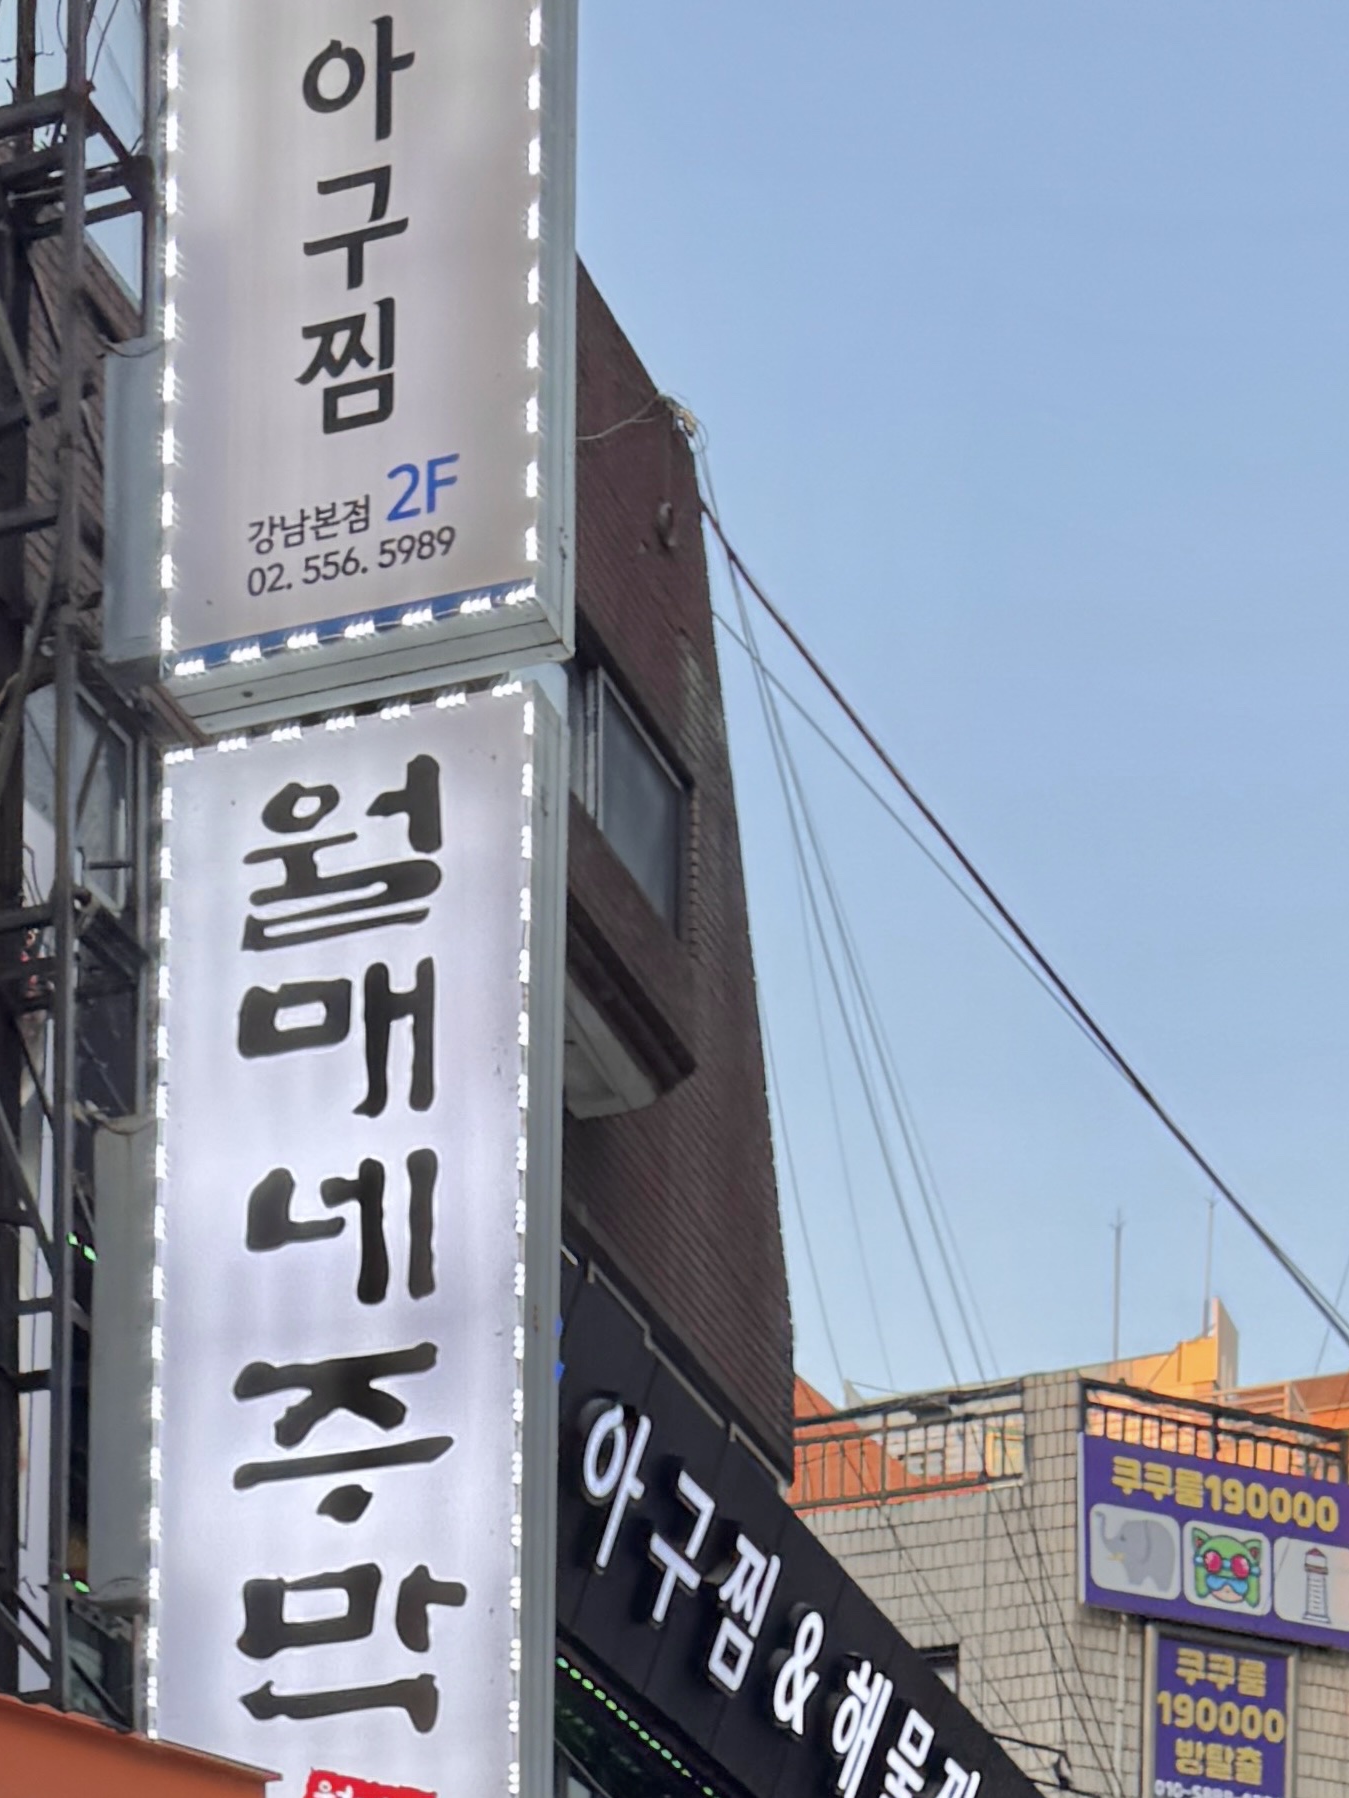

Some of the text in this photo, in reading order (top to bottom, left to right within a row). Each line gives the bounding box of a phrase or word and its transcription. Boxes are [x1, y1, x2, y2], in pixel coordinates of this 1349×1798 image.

[297, 15, 415, 435] 아구찜
[247, 453, 459, 556] 강남본점 2F
[379, 525, 456, 570] 5989
[232, 754, 466, 1733] 월매네주막
[582, 1399, 782, 1689] 아구찜
[773, 1612, 819, 1735] &
[1158, 1691, 1285, 1743] 190000
[1175, 1647, 1267, 1697] 쿠쿠룸
